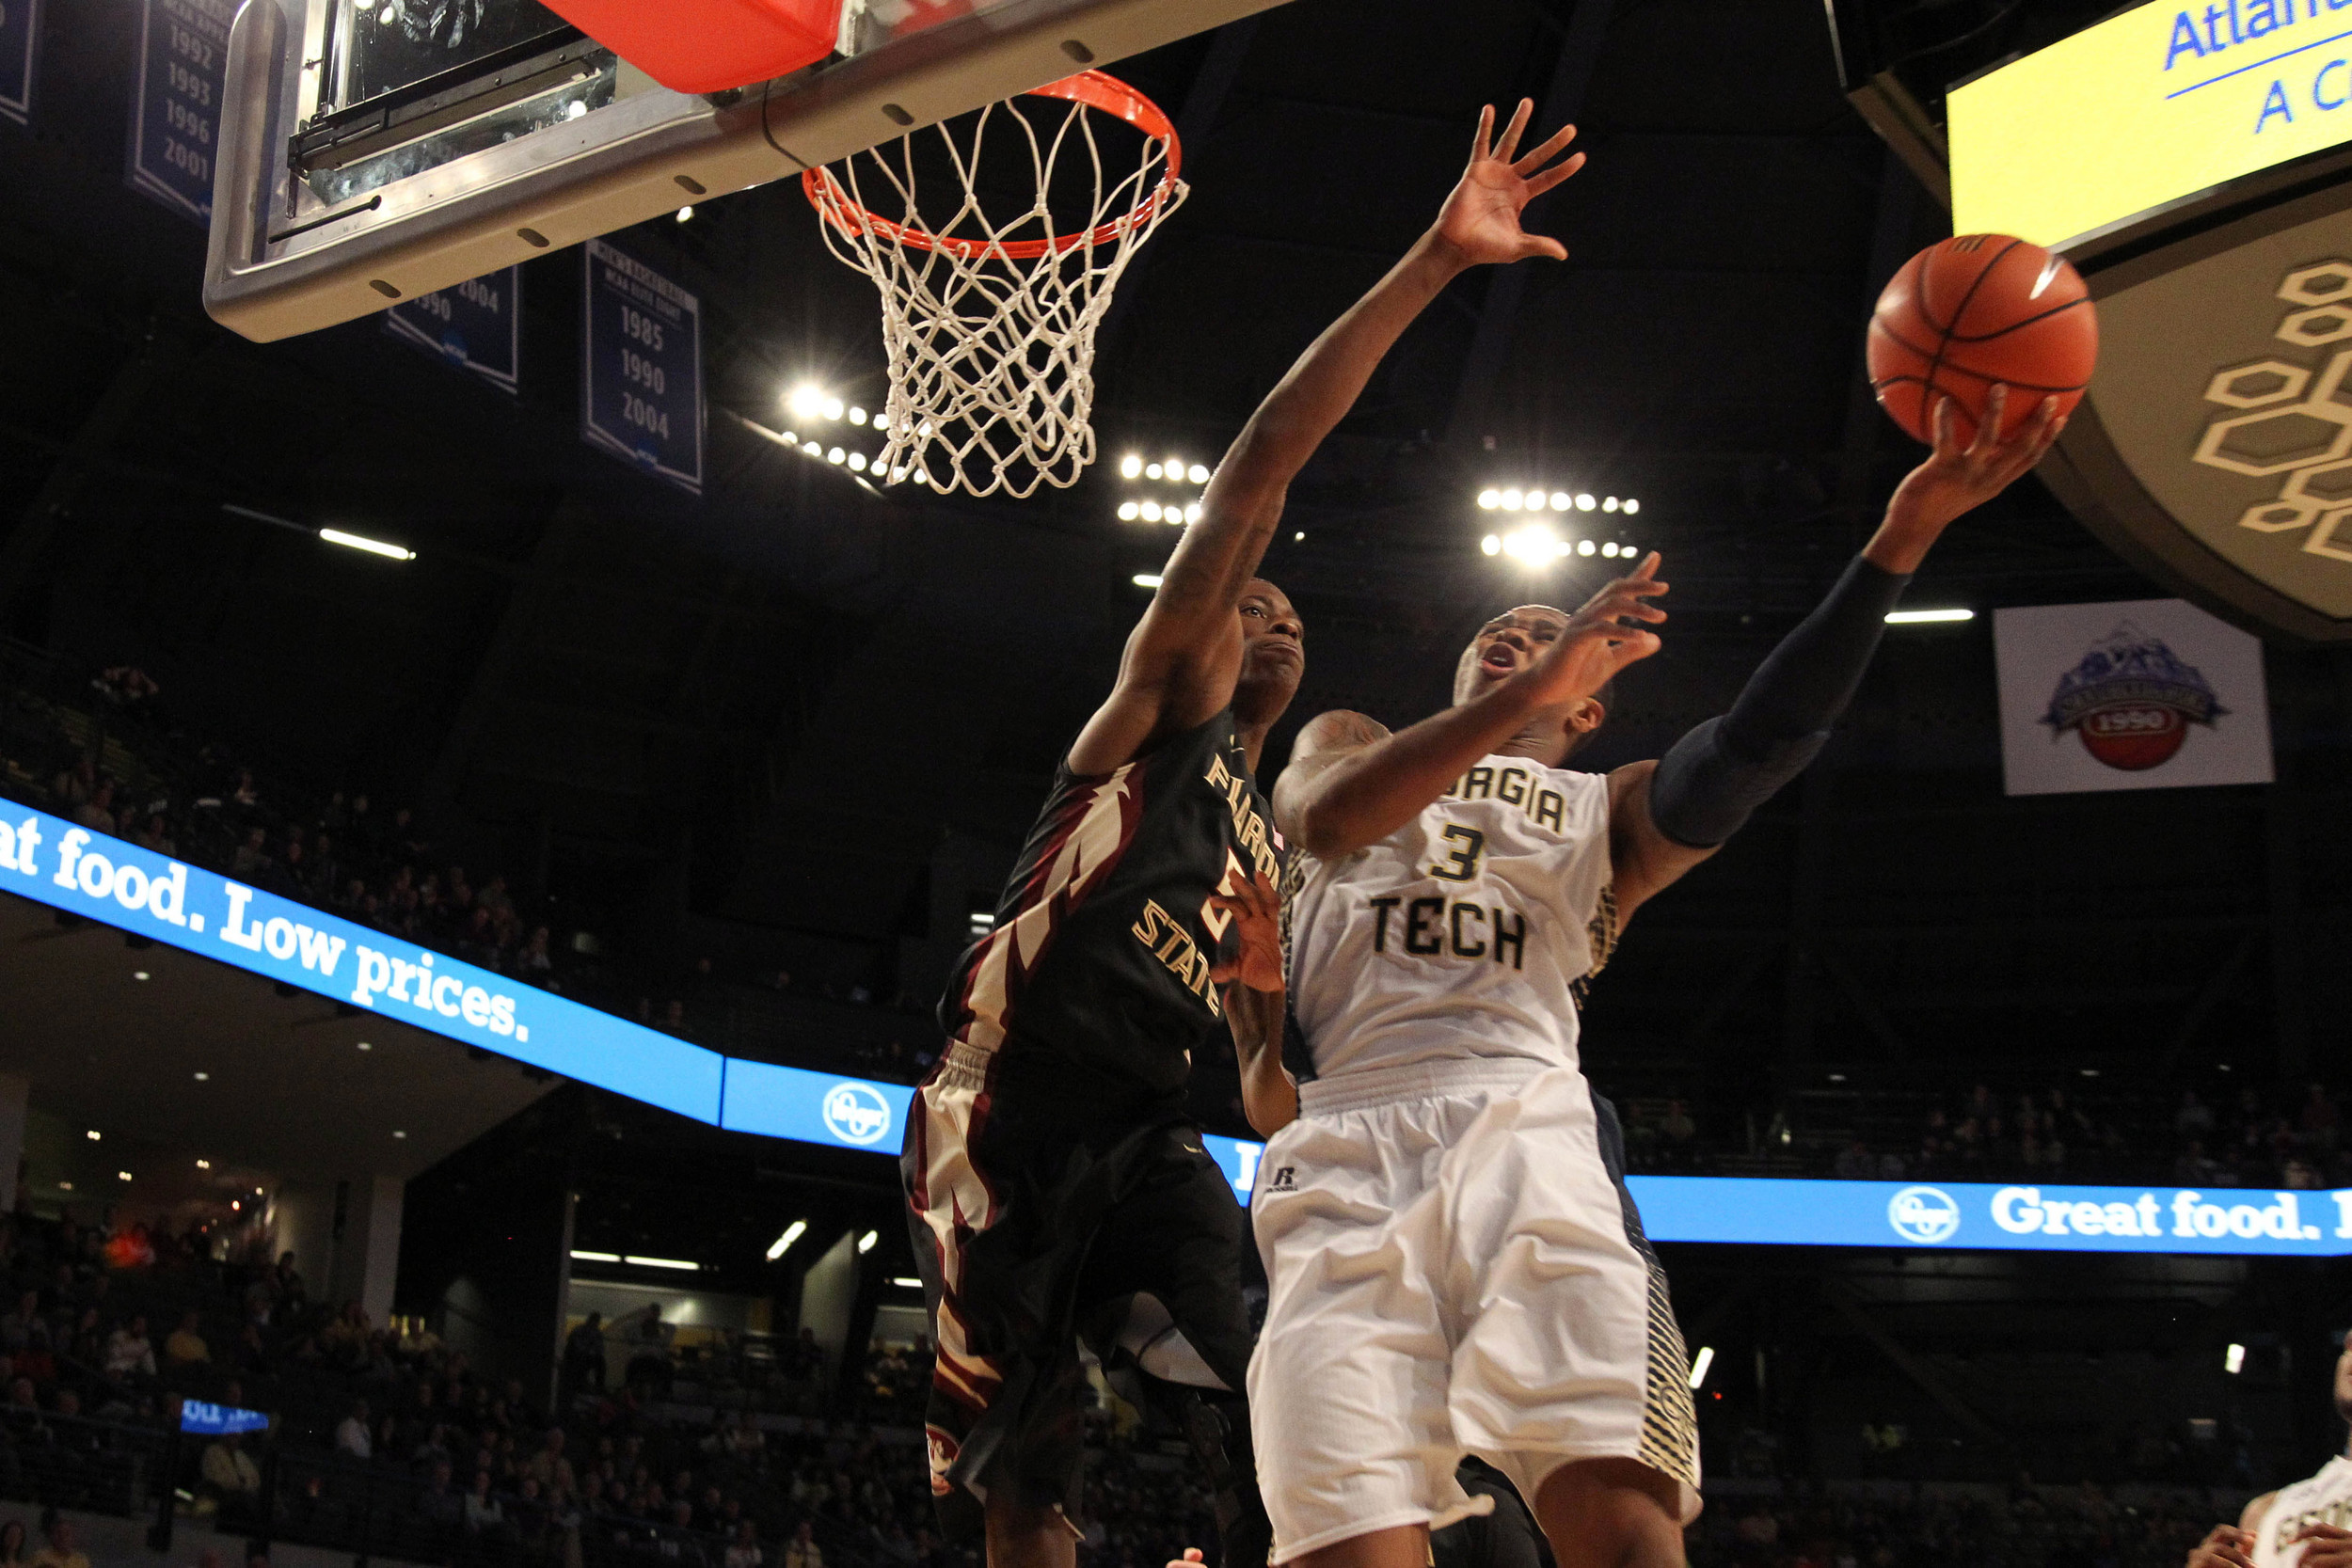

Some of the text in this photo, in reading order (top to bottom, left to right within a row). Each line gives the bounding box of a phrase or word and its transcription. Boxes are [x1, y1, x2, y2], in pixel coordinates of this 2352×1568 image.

[169, 61, 211, 106] 1993
[2254, 58, 2352, 135] A C
[167, 98, 211, 143] 1996
[164, 135, 209, 182] 2001
[414, 293, 452, 322] 990
[621, 306, 663, 352] 1985
[622, 348, 665, 395] 1990
[623, 391, 670, 440] 2004
[1443, 766, 1565, 835] RGIA
[1429, 821, 1485, 883] 3
[53, 828, 205, 933] food.
[219, 881, 346, 976] Low
[351, 945, 529, 1042] prices.
[1370, 896, 1527, 972] TECH
[1991, 1187, 2163, 1237] Great
[2172, 1191, 2321, 1241] food.
